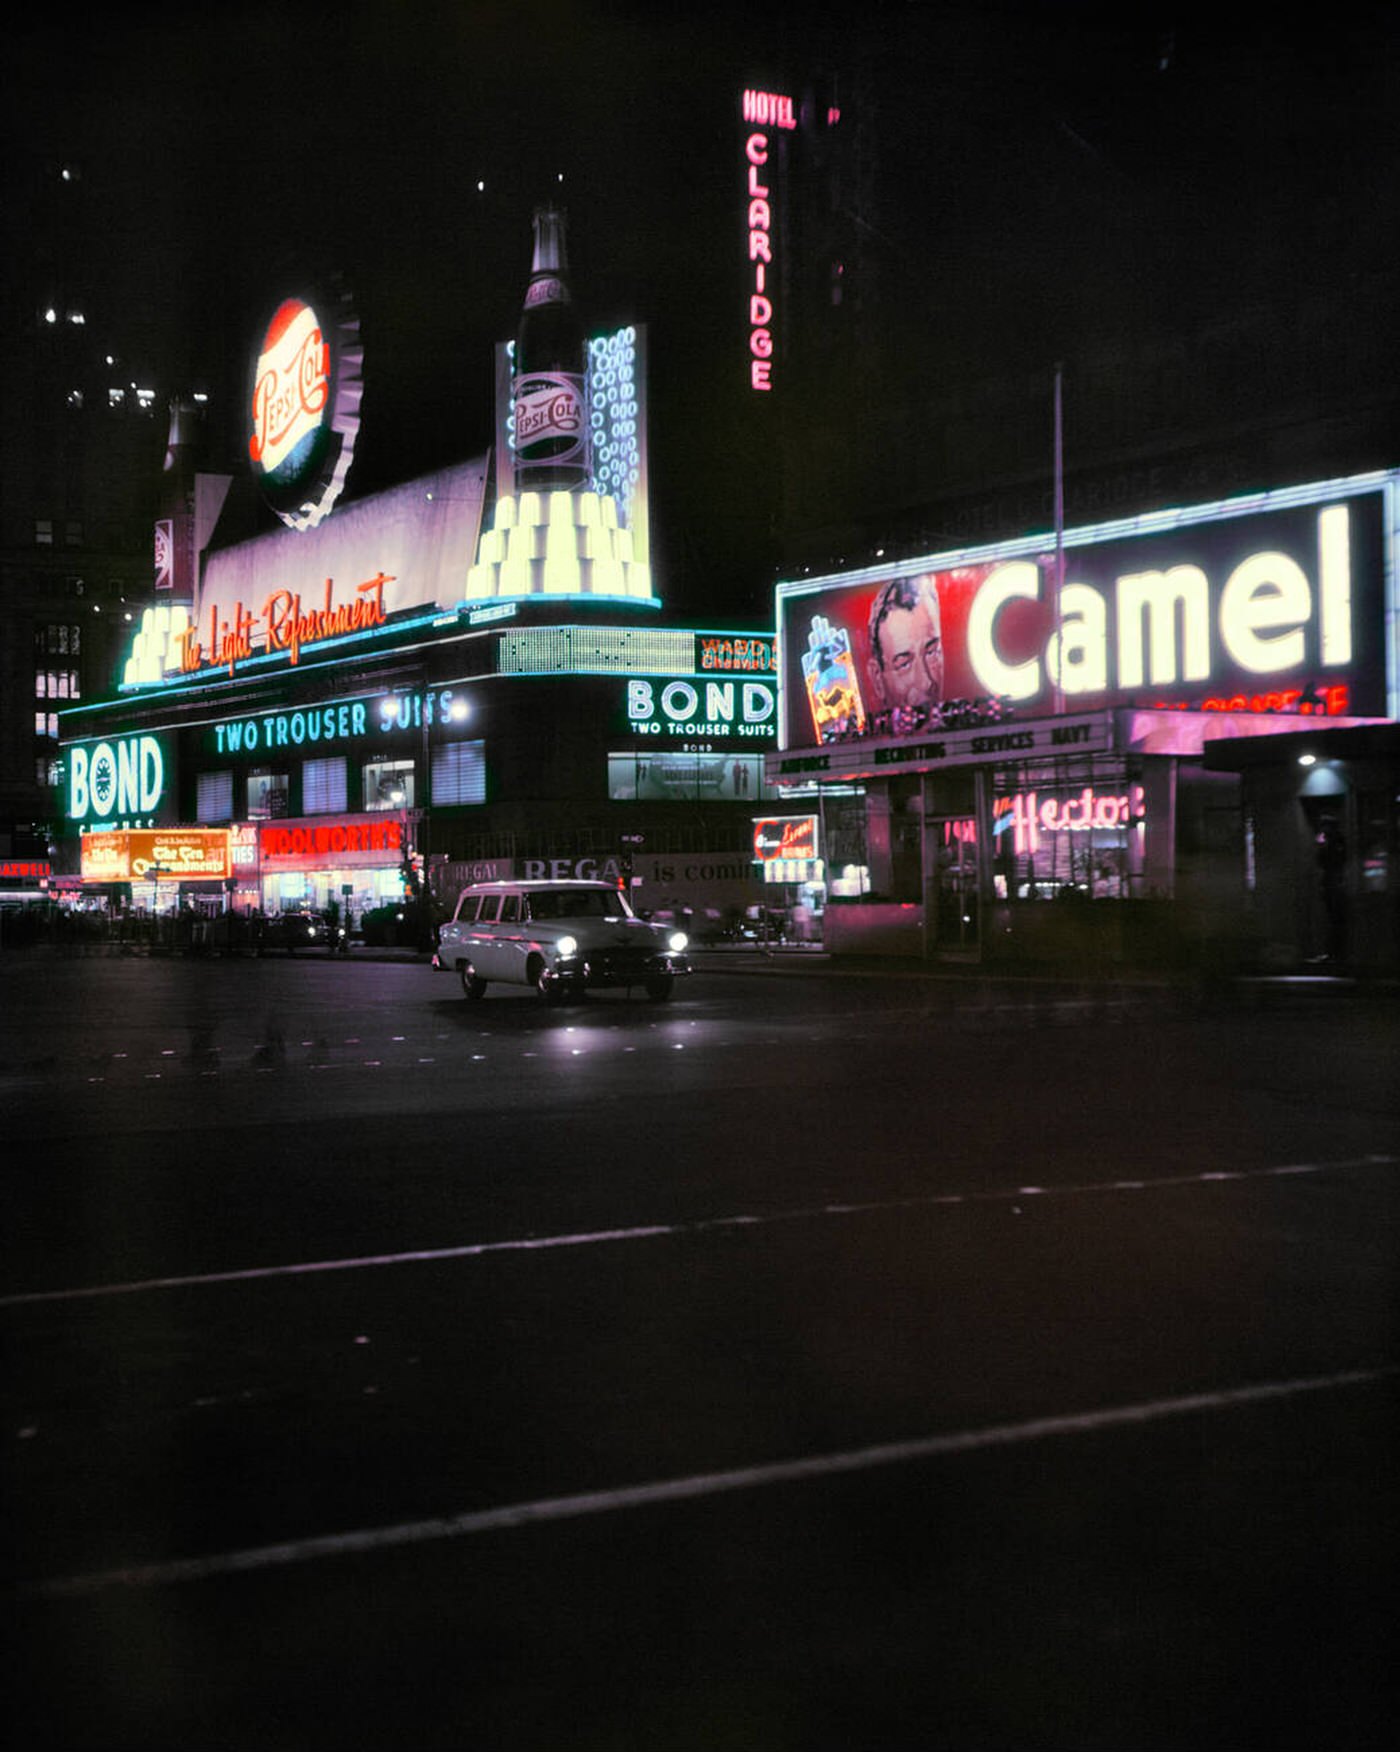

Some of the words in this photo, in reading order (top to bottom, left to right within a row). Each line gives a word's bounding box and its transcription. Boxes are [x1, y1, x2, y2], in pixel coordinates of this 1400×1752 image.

[743, 89, 796, 129] HOTEL
[746, 133, 772, 390] CLARIDGE
[967, 505, 1352, 699] Camel
[174, 615, 202, 672] The
[207, 602, 259, 677] Light
[262, 571, 397, 664] Refreshment
[627, 679, 774, 722] BOND
[215, 720, 258, 753] TWO
[264, 703, 365, 747] TROUSER
[380, 690, 453, 732] SUITS
[630, 721, 661, 735] TWO
[667, 722, 730, 736] TROUSER
[737, 723, 775, 737] SUITS
[970, 731, 1035, 755] SERVICES
[1051, 724, 1091, 746] NAVY
[683, 743, 713, 752] BOND
[70, 735, 164, 819] BOND
[260, 819, 402, 855] WOOLWORTH'S
[523, 858, 621, 881] REGA
[654, 861, 675, 881] is
